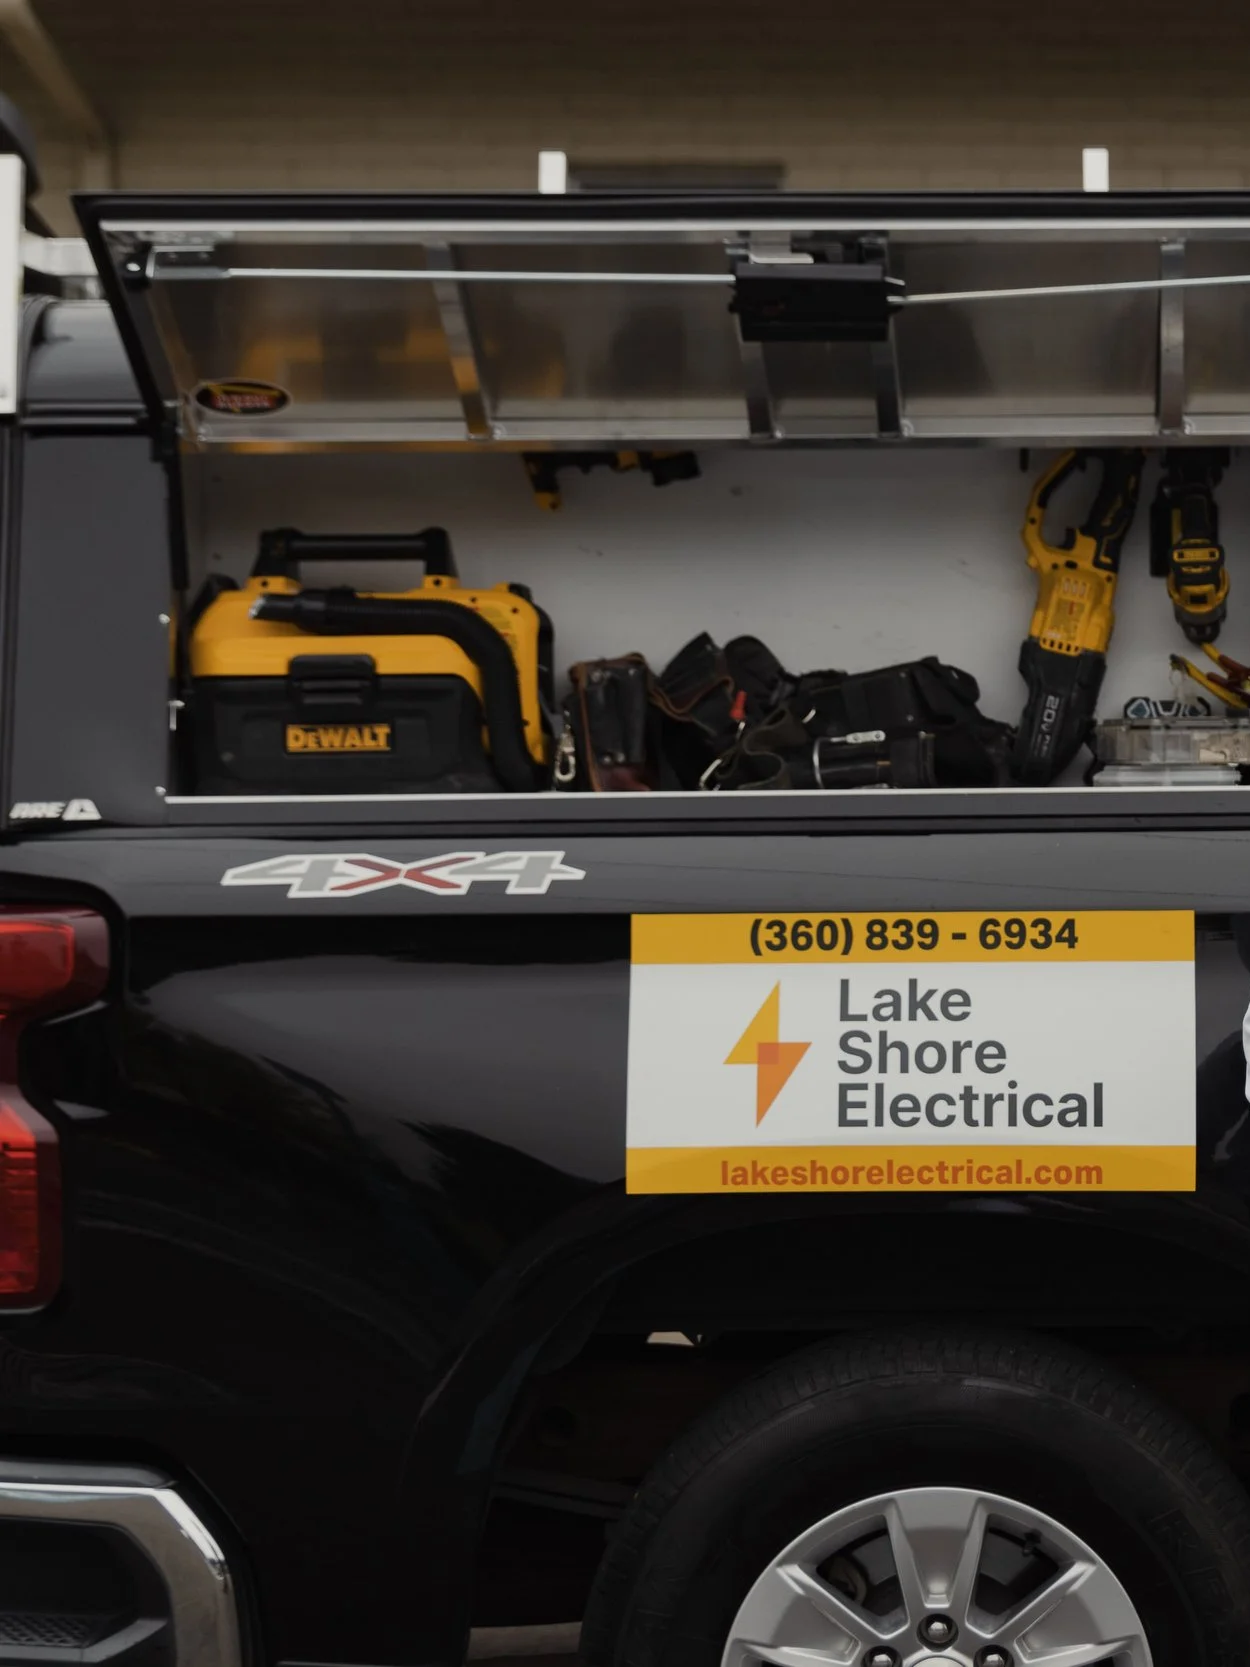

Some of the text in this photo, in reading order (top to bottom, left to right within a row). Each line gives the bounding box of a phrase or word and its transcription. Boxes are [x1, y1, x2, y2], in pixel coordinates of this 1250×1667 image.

[750, 918, 854, 956] (360)
[865, 918, 940, 951] 839
[979, 918, 1079, 950] 6934
[839, 978, 972, 1022] Lake
[837, 1030, 1007, 1075] Shore
[837, 1080, 1104, 1128] Electrical
[720, 1159, 1104, 1187] lakeshorelectrical.com
